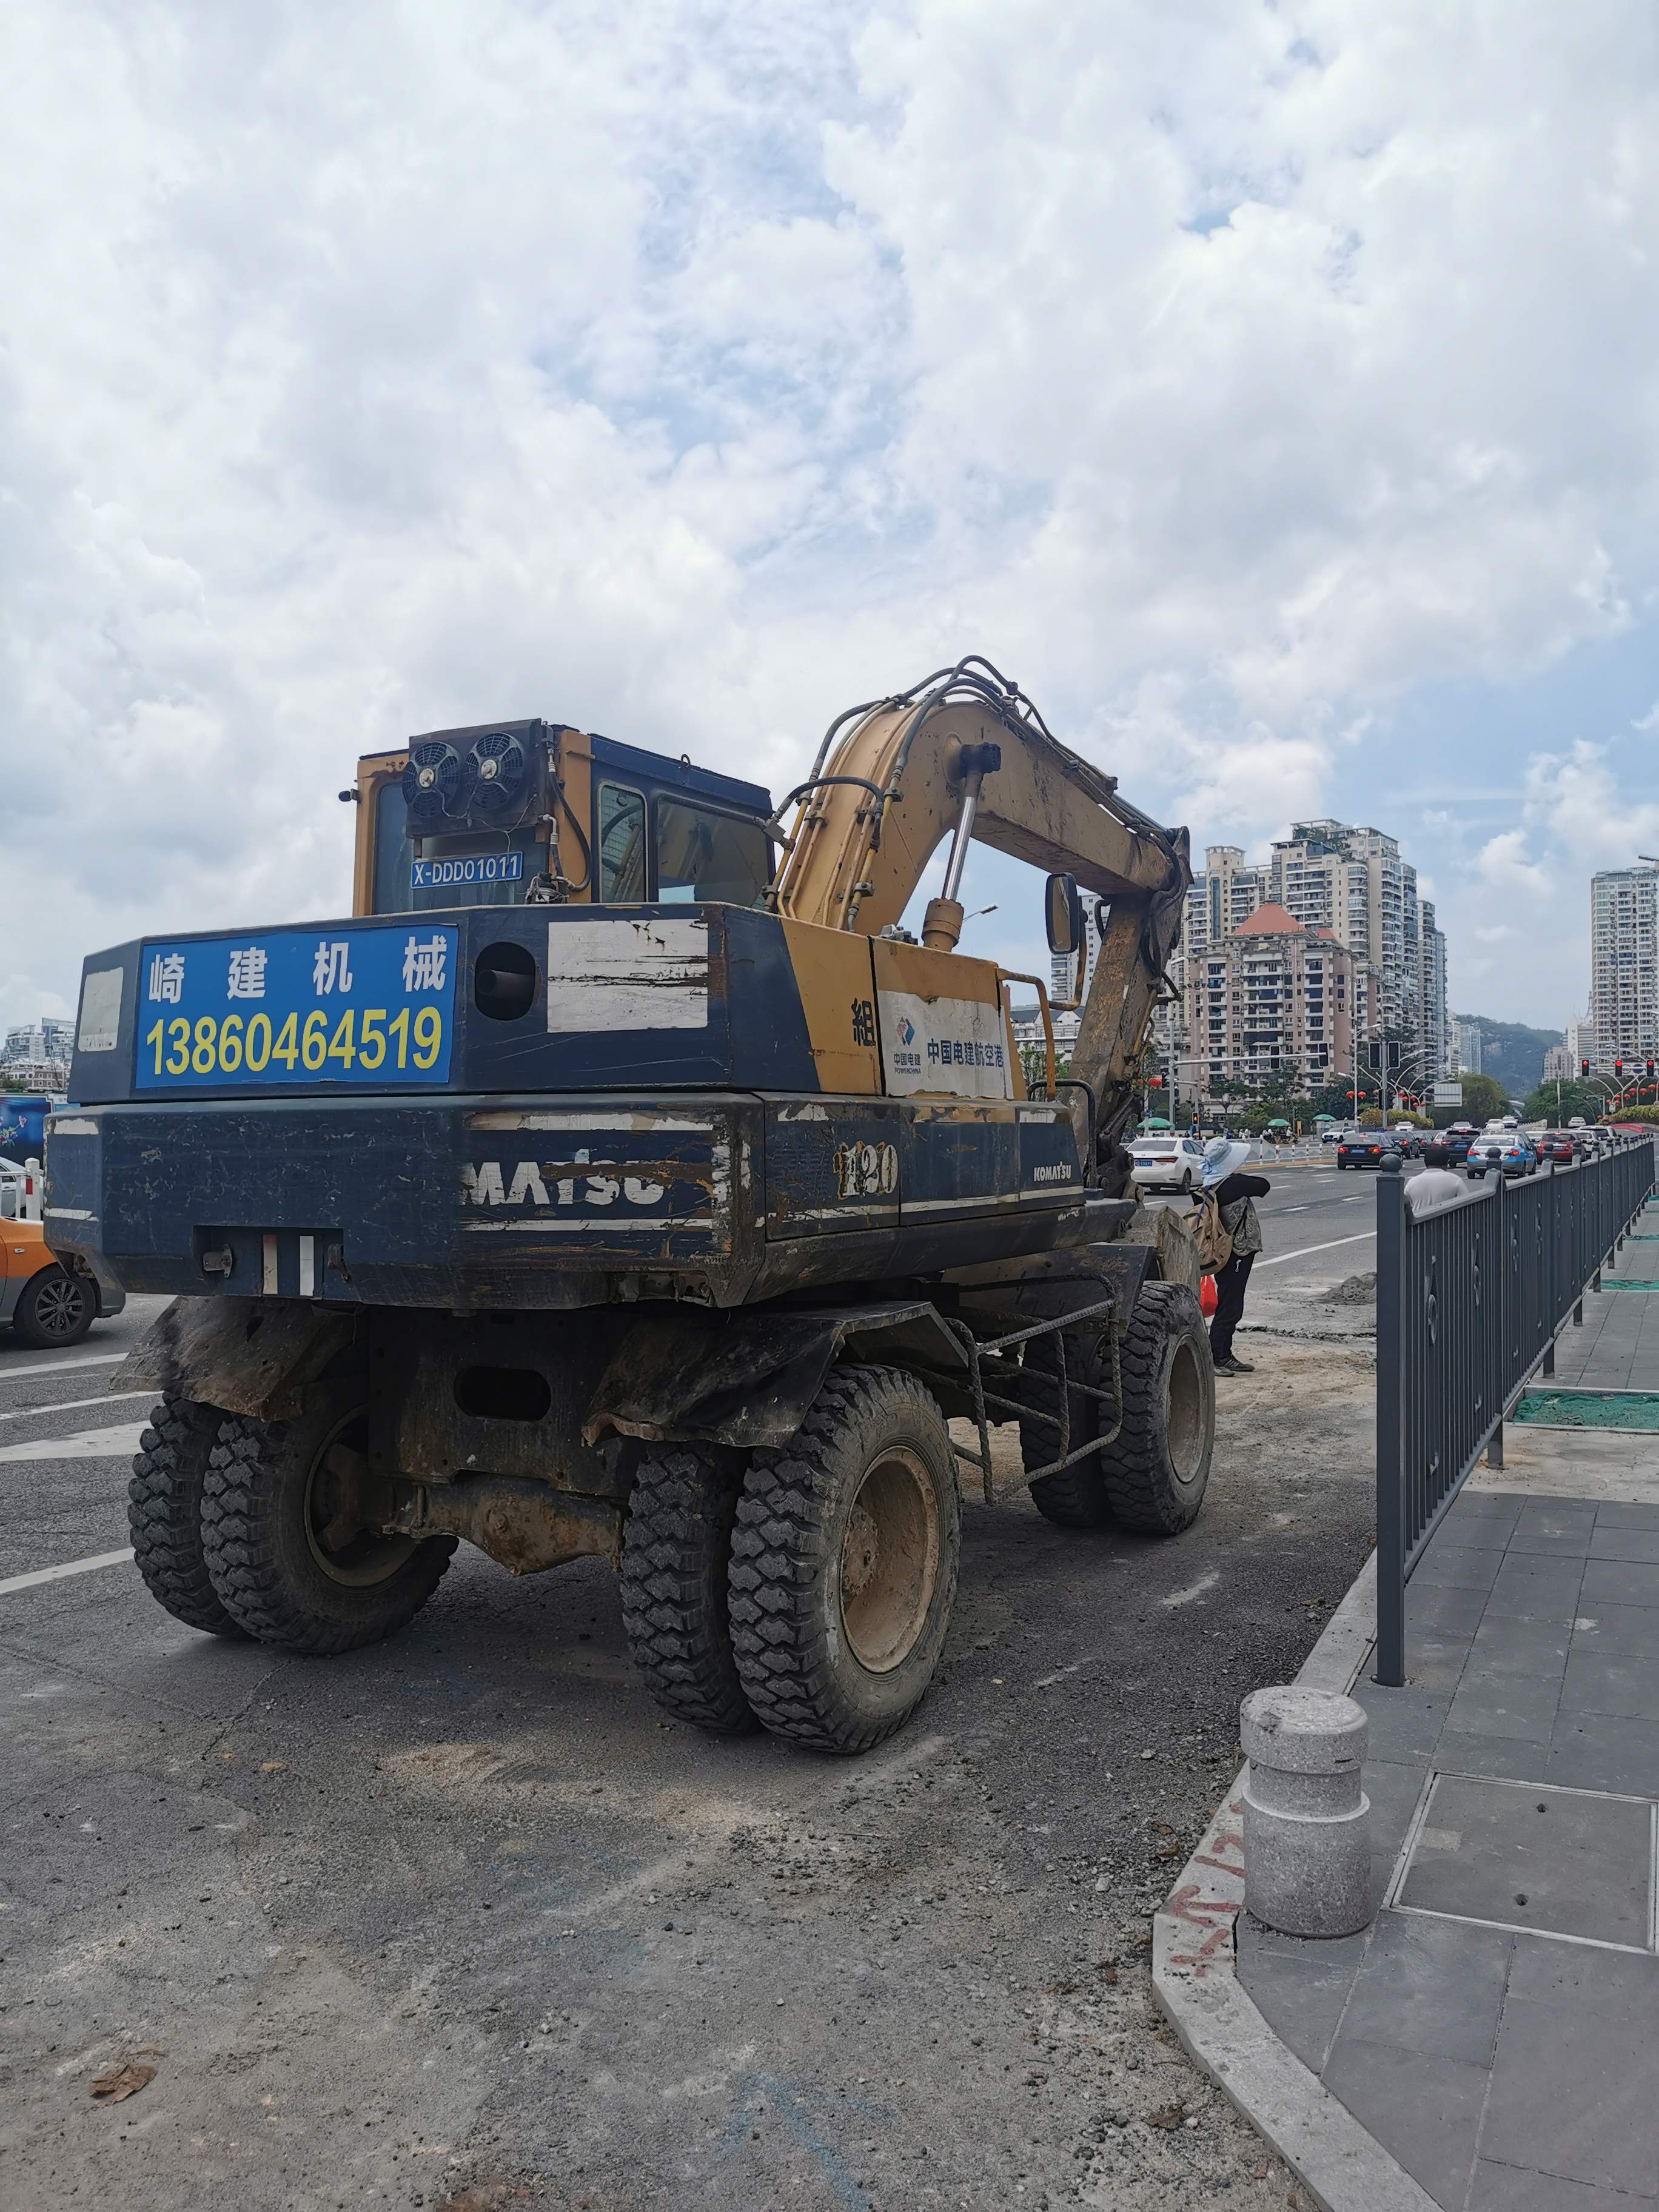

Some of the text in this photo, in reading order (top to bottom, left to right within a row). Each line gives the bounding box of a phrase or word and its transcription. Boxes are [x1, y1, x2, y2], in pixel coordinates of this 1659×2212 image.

[414, 855, 517, 885] X-DDD01011
[149, 934, 447, 1004] 崎建机械
[147, 1007, 442, 1075] 13860464519
[927, 1037, 1004, 1068] 中国电建航空港
[894, 1052, 921, 1066] 中国电建
[1034, 1161, 1071, 1182] KOMATSU
